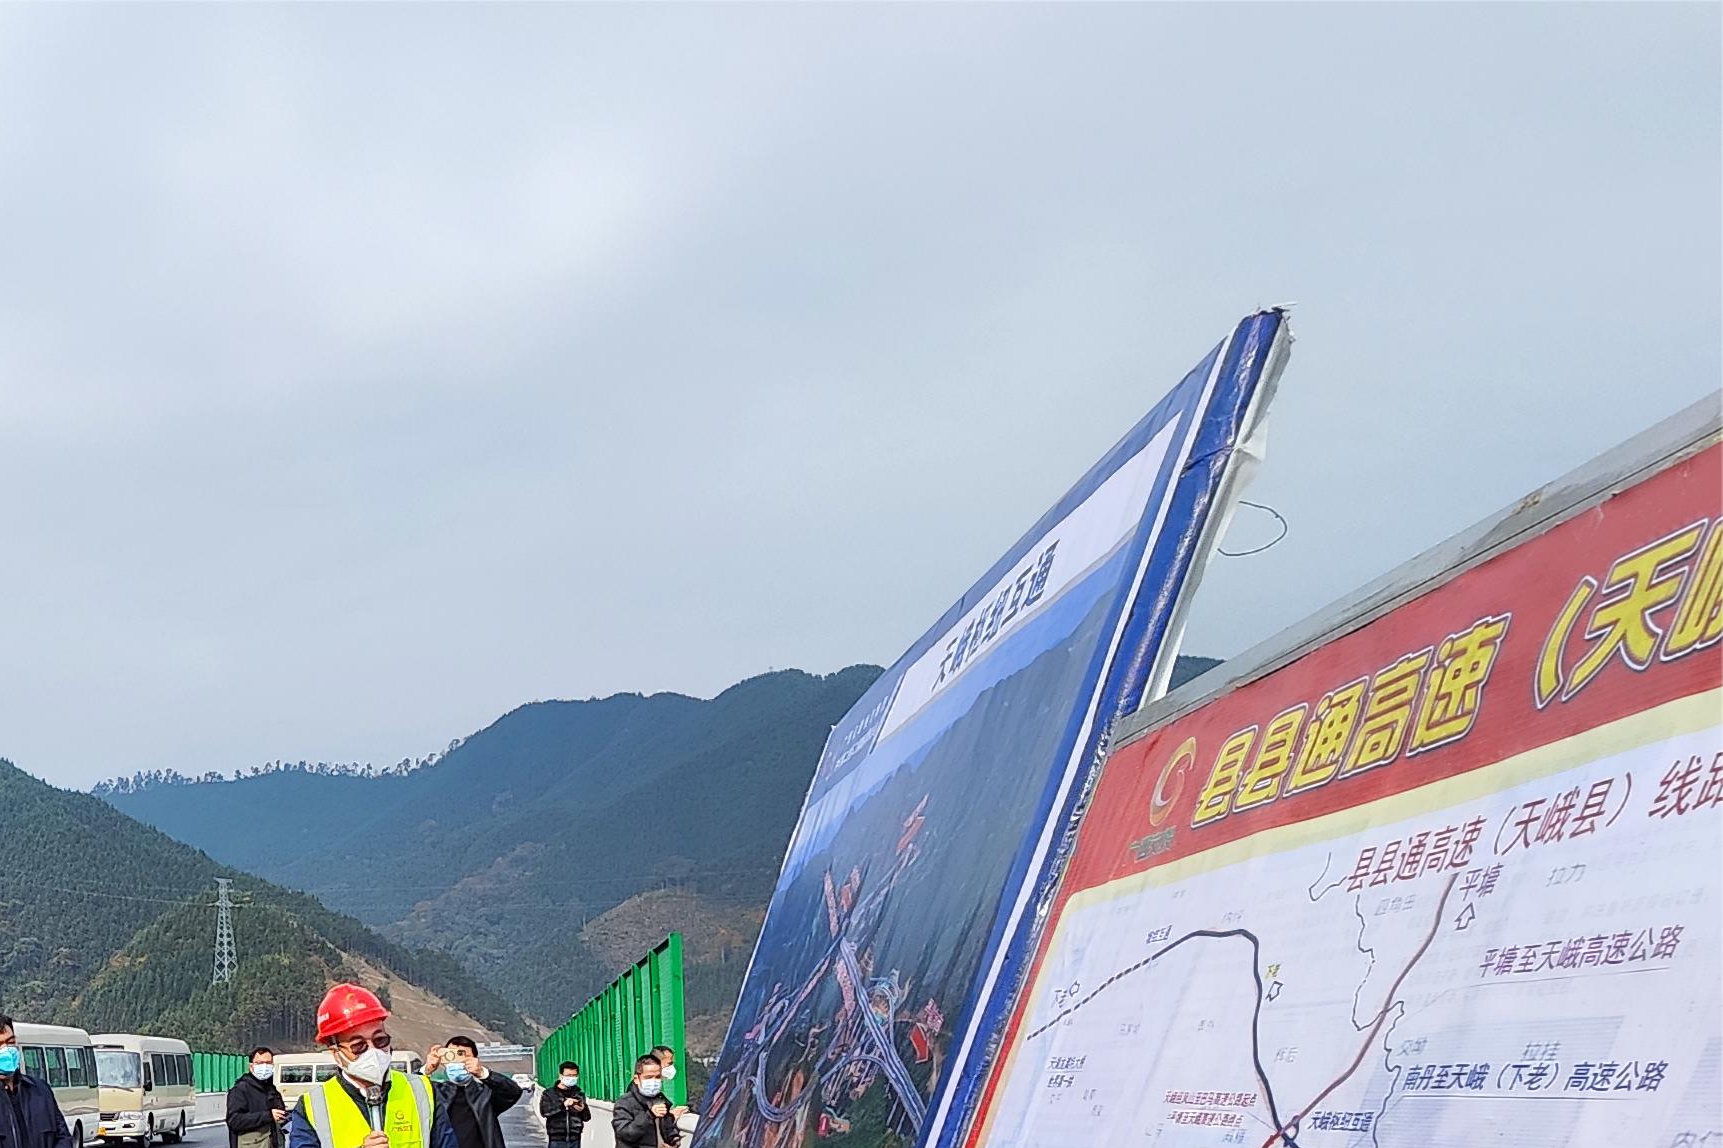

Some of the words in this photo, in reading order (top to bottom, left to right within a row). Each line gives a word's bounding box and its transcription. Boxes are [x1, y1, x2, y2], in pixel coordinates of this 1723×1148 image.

[1459, 863, 1504, 901] 平塘
[1479, 925, 1684, 978] 平塘至天峨高速公路
[1402, 1061, 1669, 1091] 南丹至天峨（下老）高速公路
